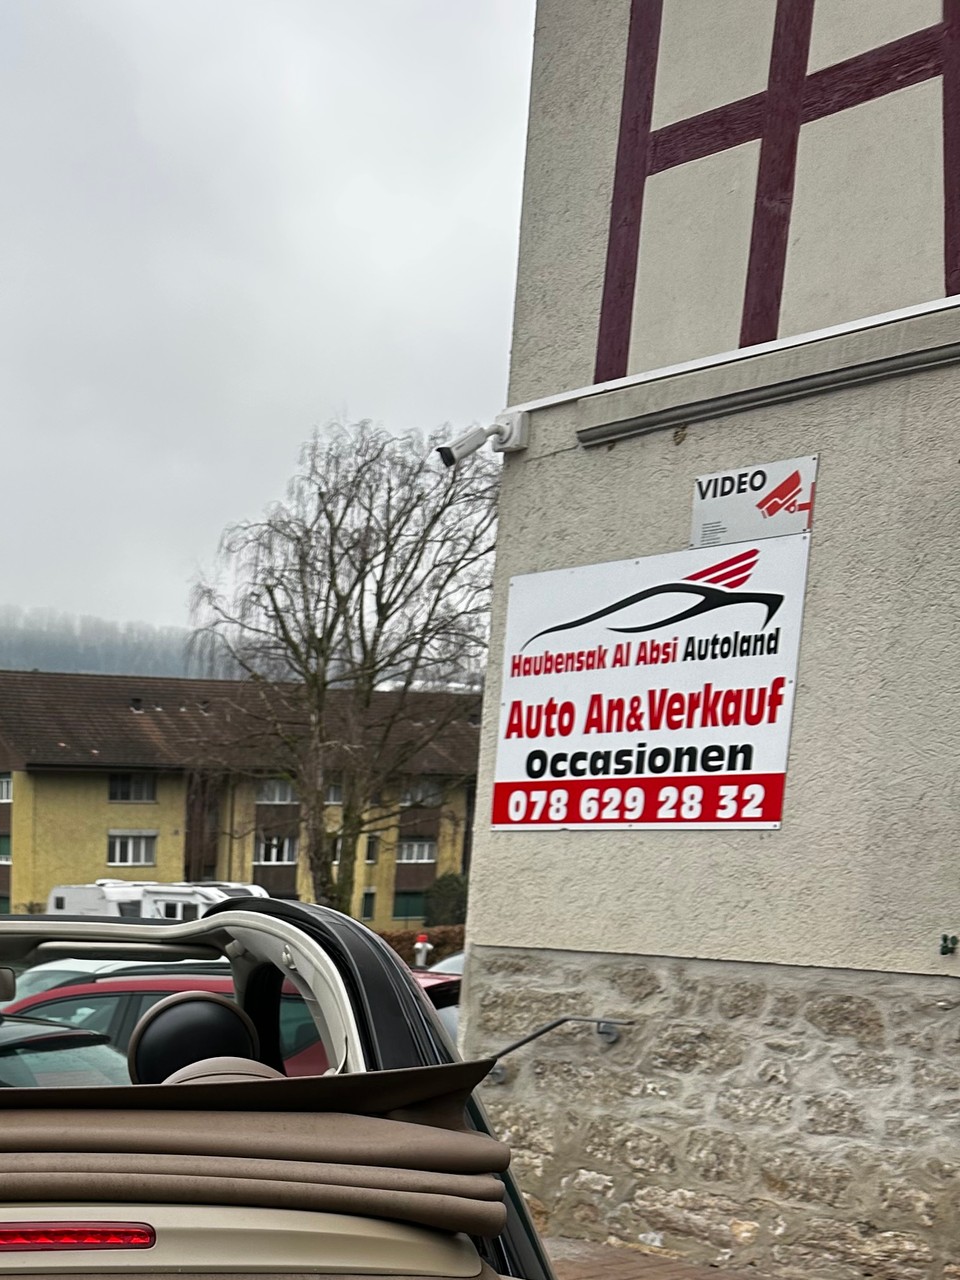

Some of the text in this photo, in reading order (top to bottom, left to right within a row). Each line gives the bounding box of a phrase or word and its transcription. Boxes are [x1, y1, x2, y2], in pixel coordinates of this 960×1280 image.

[697, 469, 767, 500] VIDEO
[510, 627, 780, 678] Haubensak Al Absi Autoland
[504, 676, 786, 740] Auto An&Verkauf
[525, 742, 753, 779] Occasionen
[507, 783, 766, 821] 078 629 28 32
